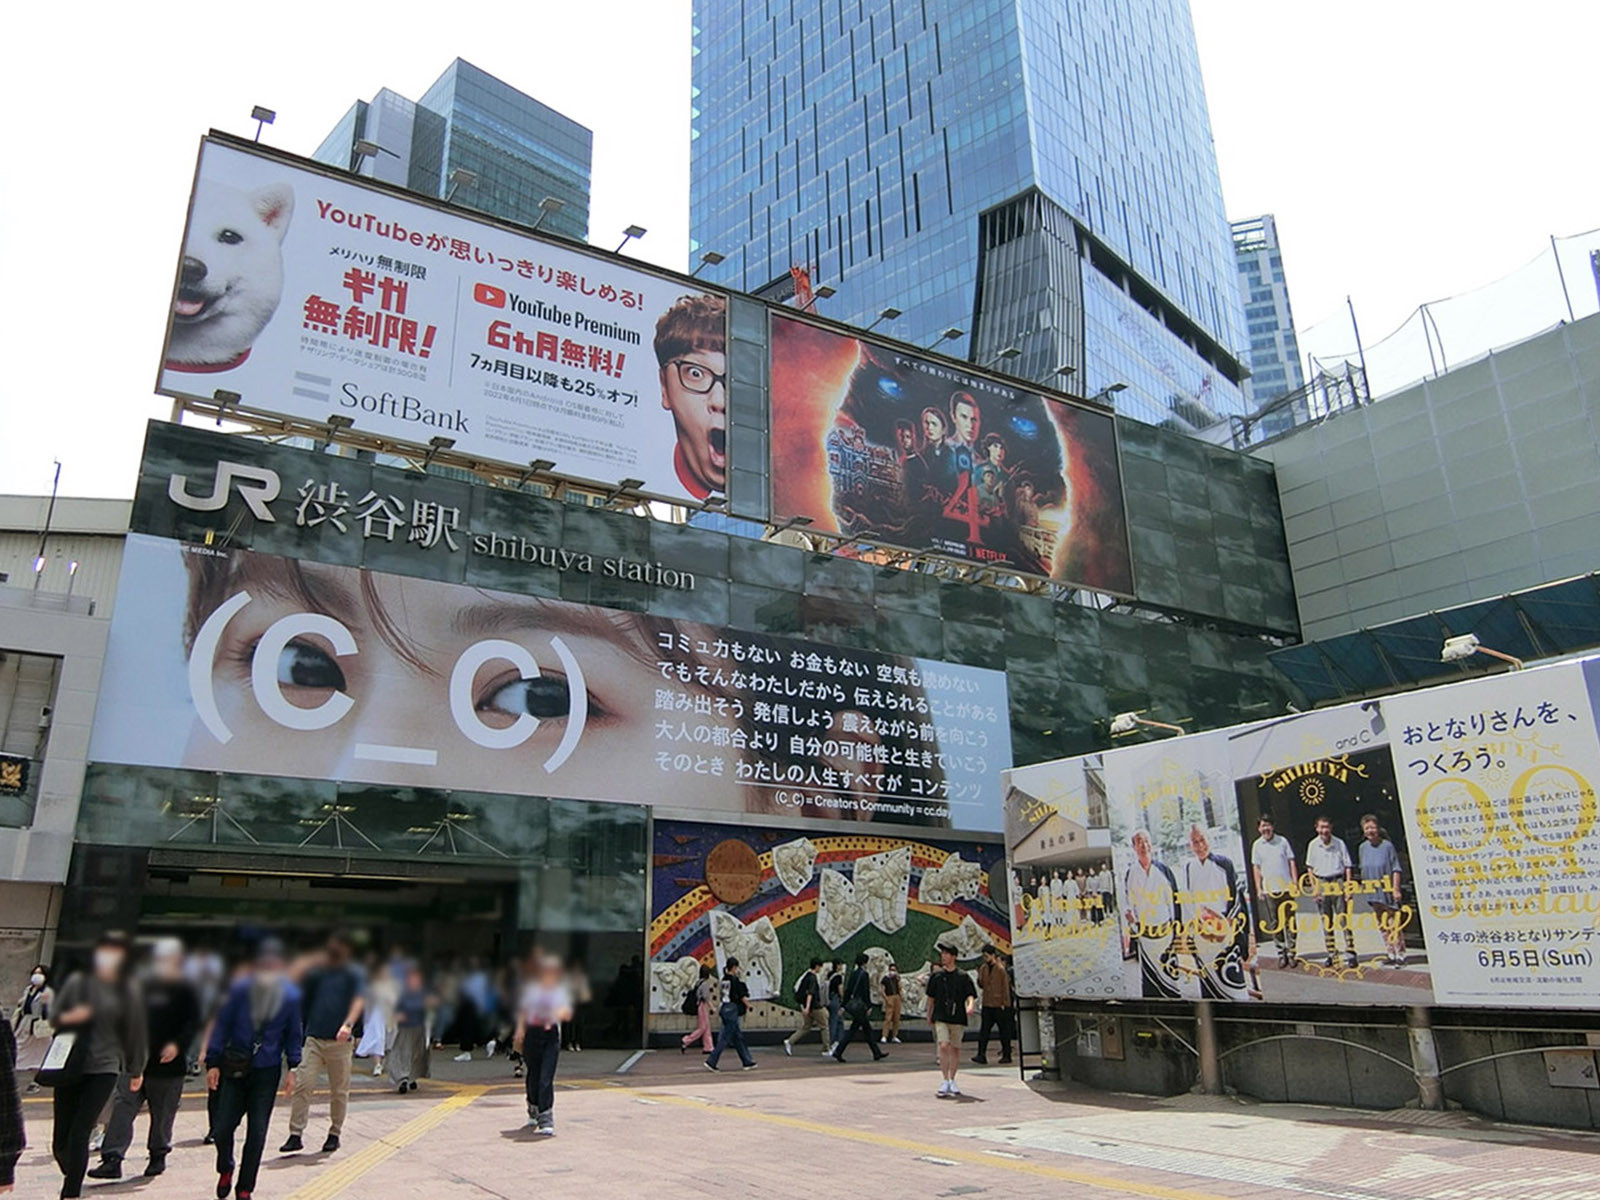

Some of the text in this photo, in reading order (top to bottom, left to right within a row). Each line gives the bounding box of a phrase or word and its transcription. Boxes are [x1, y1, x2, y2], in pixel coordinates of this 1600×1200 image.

[329, 246, 428, 281] メリハリ無制限
[342, 267, 409, 315] ギガ
[302, 294, 438, 359] 無制限!
[508, 293, 641, 346] YouTube Premium
[339, 382, 471, 434] SoftBank
[168, 460, 462, 552] JR 渋谷駅
[473, 531, 697, 592] shibuya station
[656, 660, 999, 723] でもそんなわたしだから 伝えられることがある
[789, 651, 870, 678] お金もない
[876, 663, 981, 694] 空気も読めない
[654, 688, 989, 748] 踏み出そう 発信しよう 震えながら前を向こう
[1403, 701, 1578, 746] おとなりさんを、
[654, 719, 988, 775] 大人の都合より 自分の可能性と生きていこう
[1335, 735, 1359, 750] and
[1407, 747, 1506, 776] つくろう。
[654, 751, 983, 800] そのとき わたしの人生すべてが コンテンツ
[1272, 760, 1350, 793] SHIBUYA
[814, 797, 859, 811] Creators
[860, 801, 915, 818] Community
[1259, 898, 1413, 945] Sunday
[1437, 926, 1600, 945] 今年の渋谷おとなりサンデ
